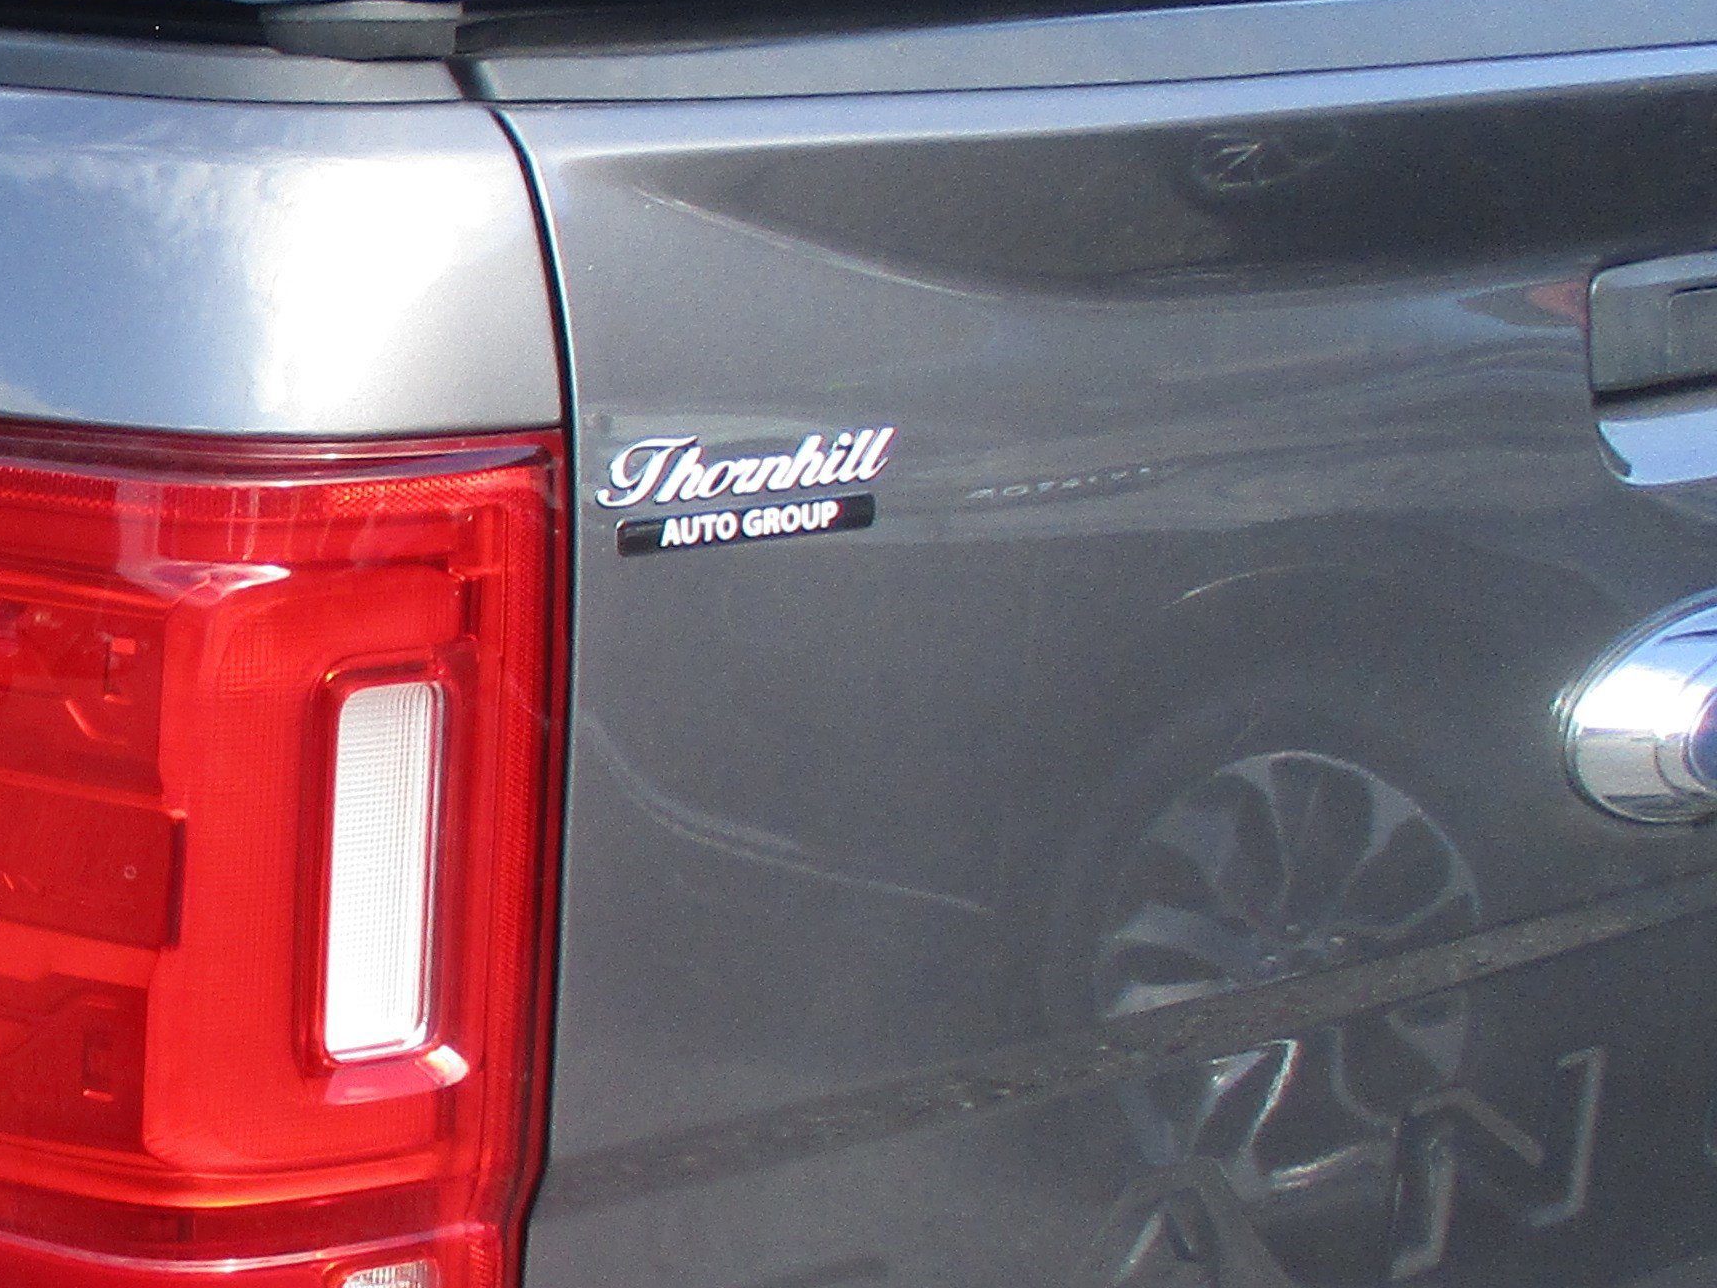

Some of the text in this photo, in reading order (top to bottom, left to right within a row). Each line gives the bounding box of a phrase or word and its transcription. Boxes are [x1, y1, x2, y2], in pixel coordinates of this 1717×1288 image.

[595, 424, 898, 508] Thornhill
[660, 500, 841, 549] AUTO GROUP
